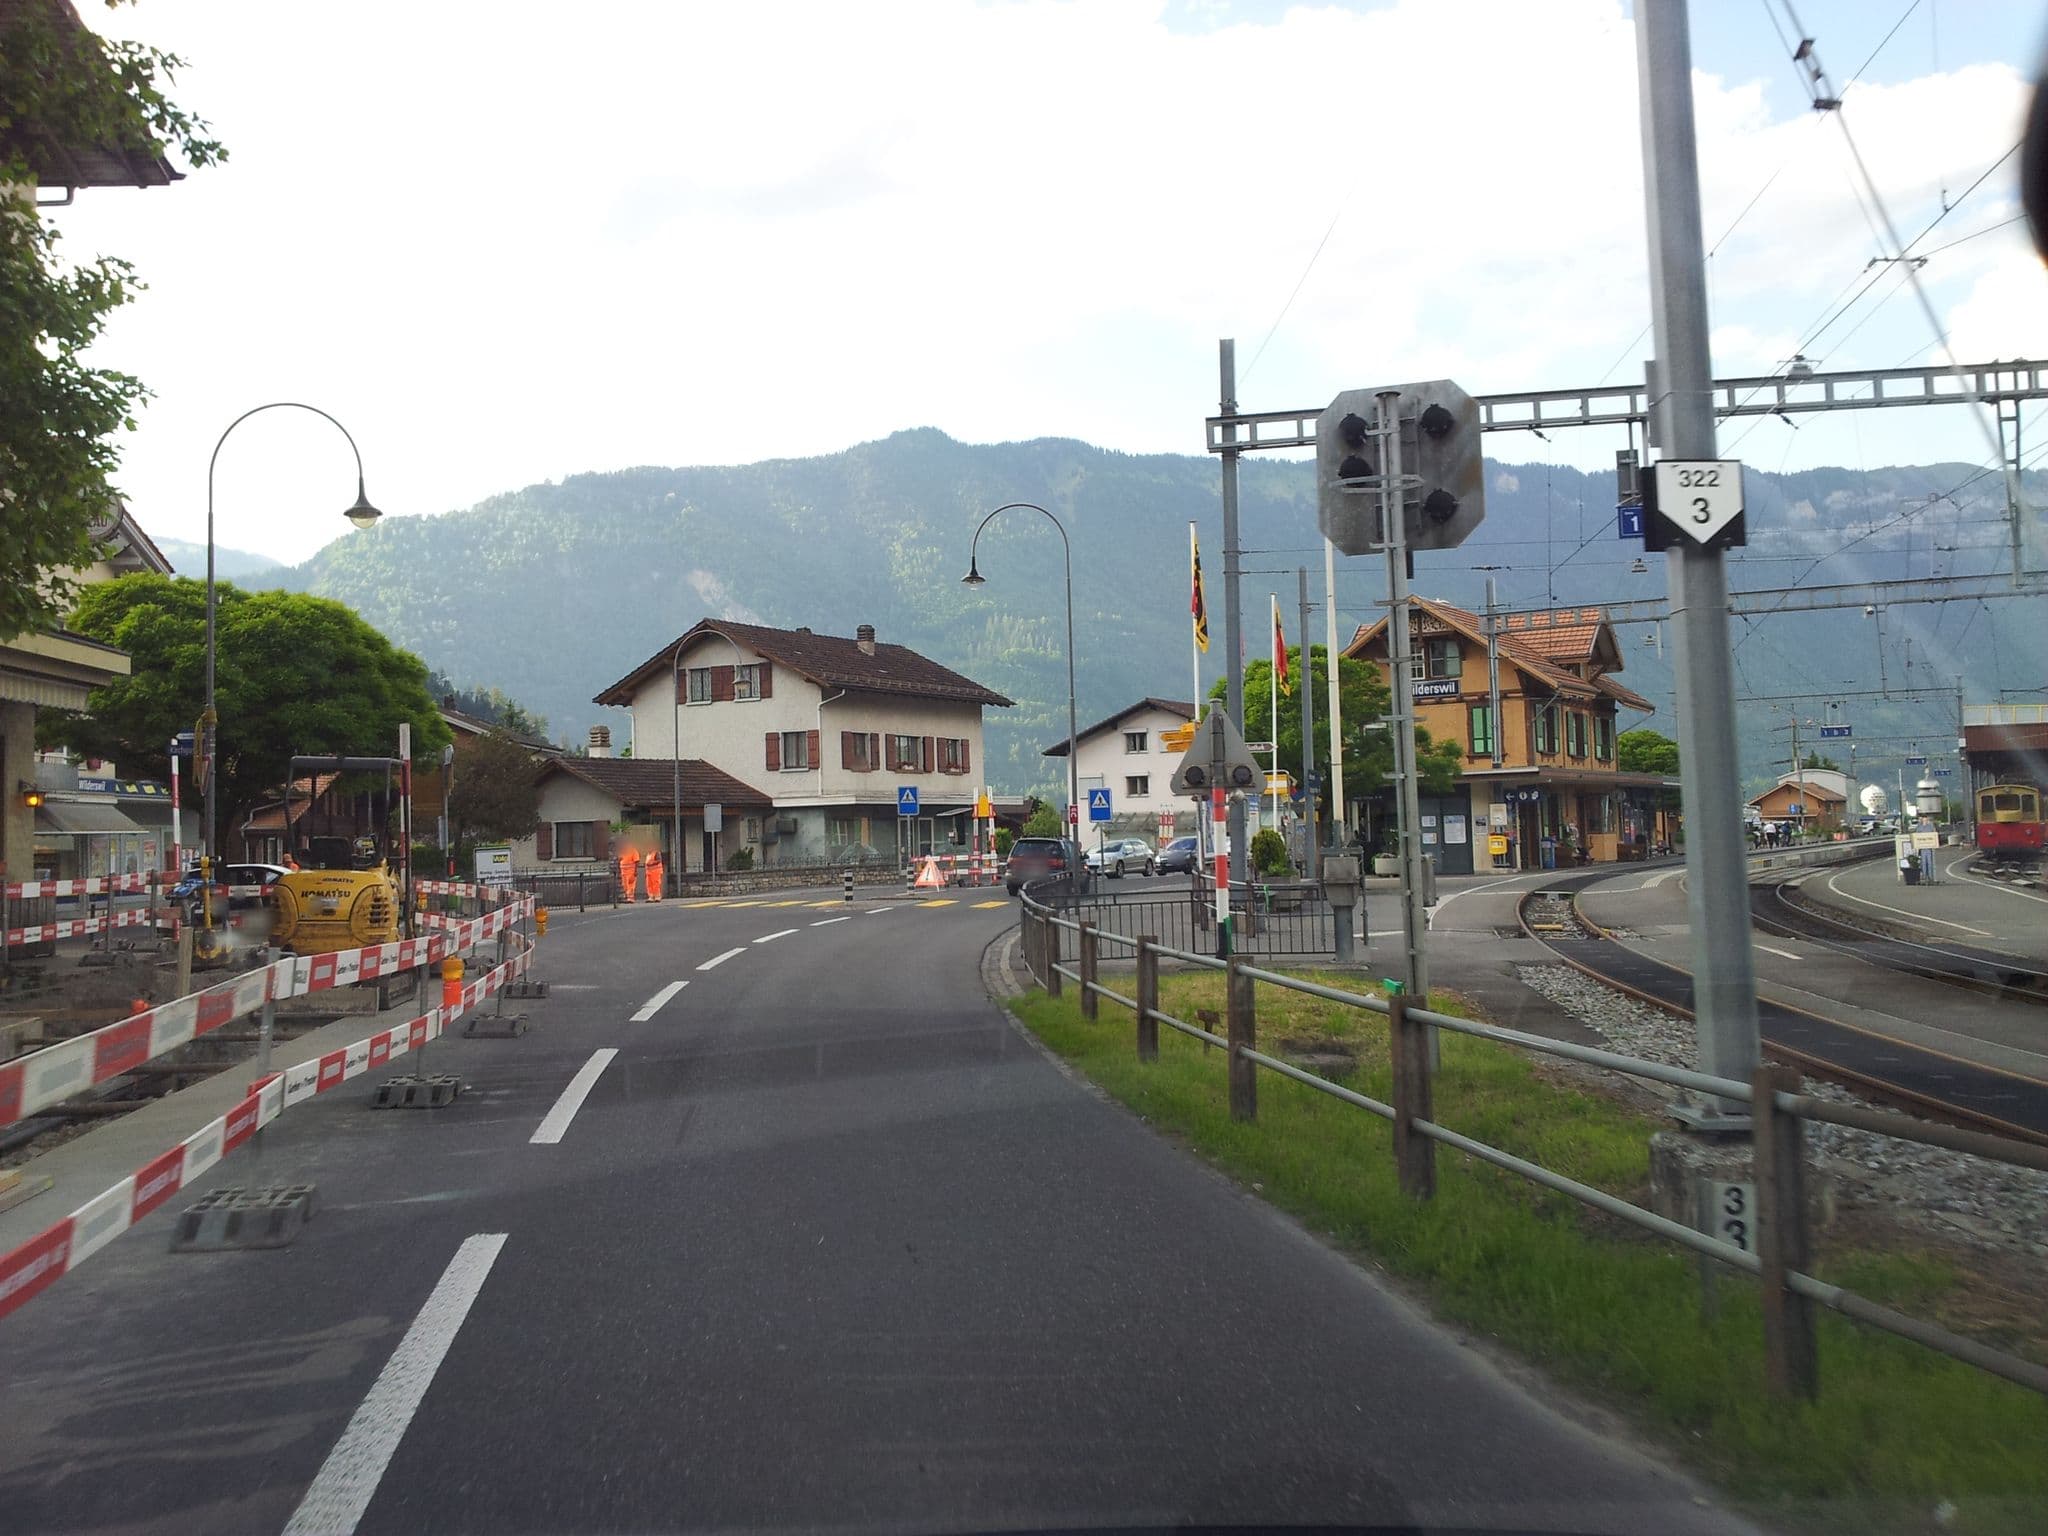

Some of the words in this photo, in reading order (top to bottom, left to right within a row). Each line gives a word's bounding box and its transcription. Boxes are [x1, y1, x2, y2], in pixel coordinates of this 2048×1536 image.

[1679, 469, 1720, 488] 322
[1692, 497, 1710, 525] 3
[1630, 515, 1639, 532] 1
[1412, 682, 1455, 695] ilderswil
[300, 888, 351, 899] KOMATSU
[1723, 1186, 1745, 1215] 3
